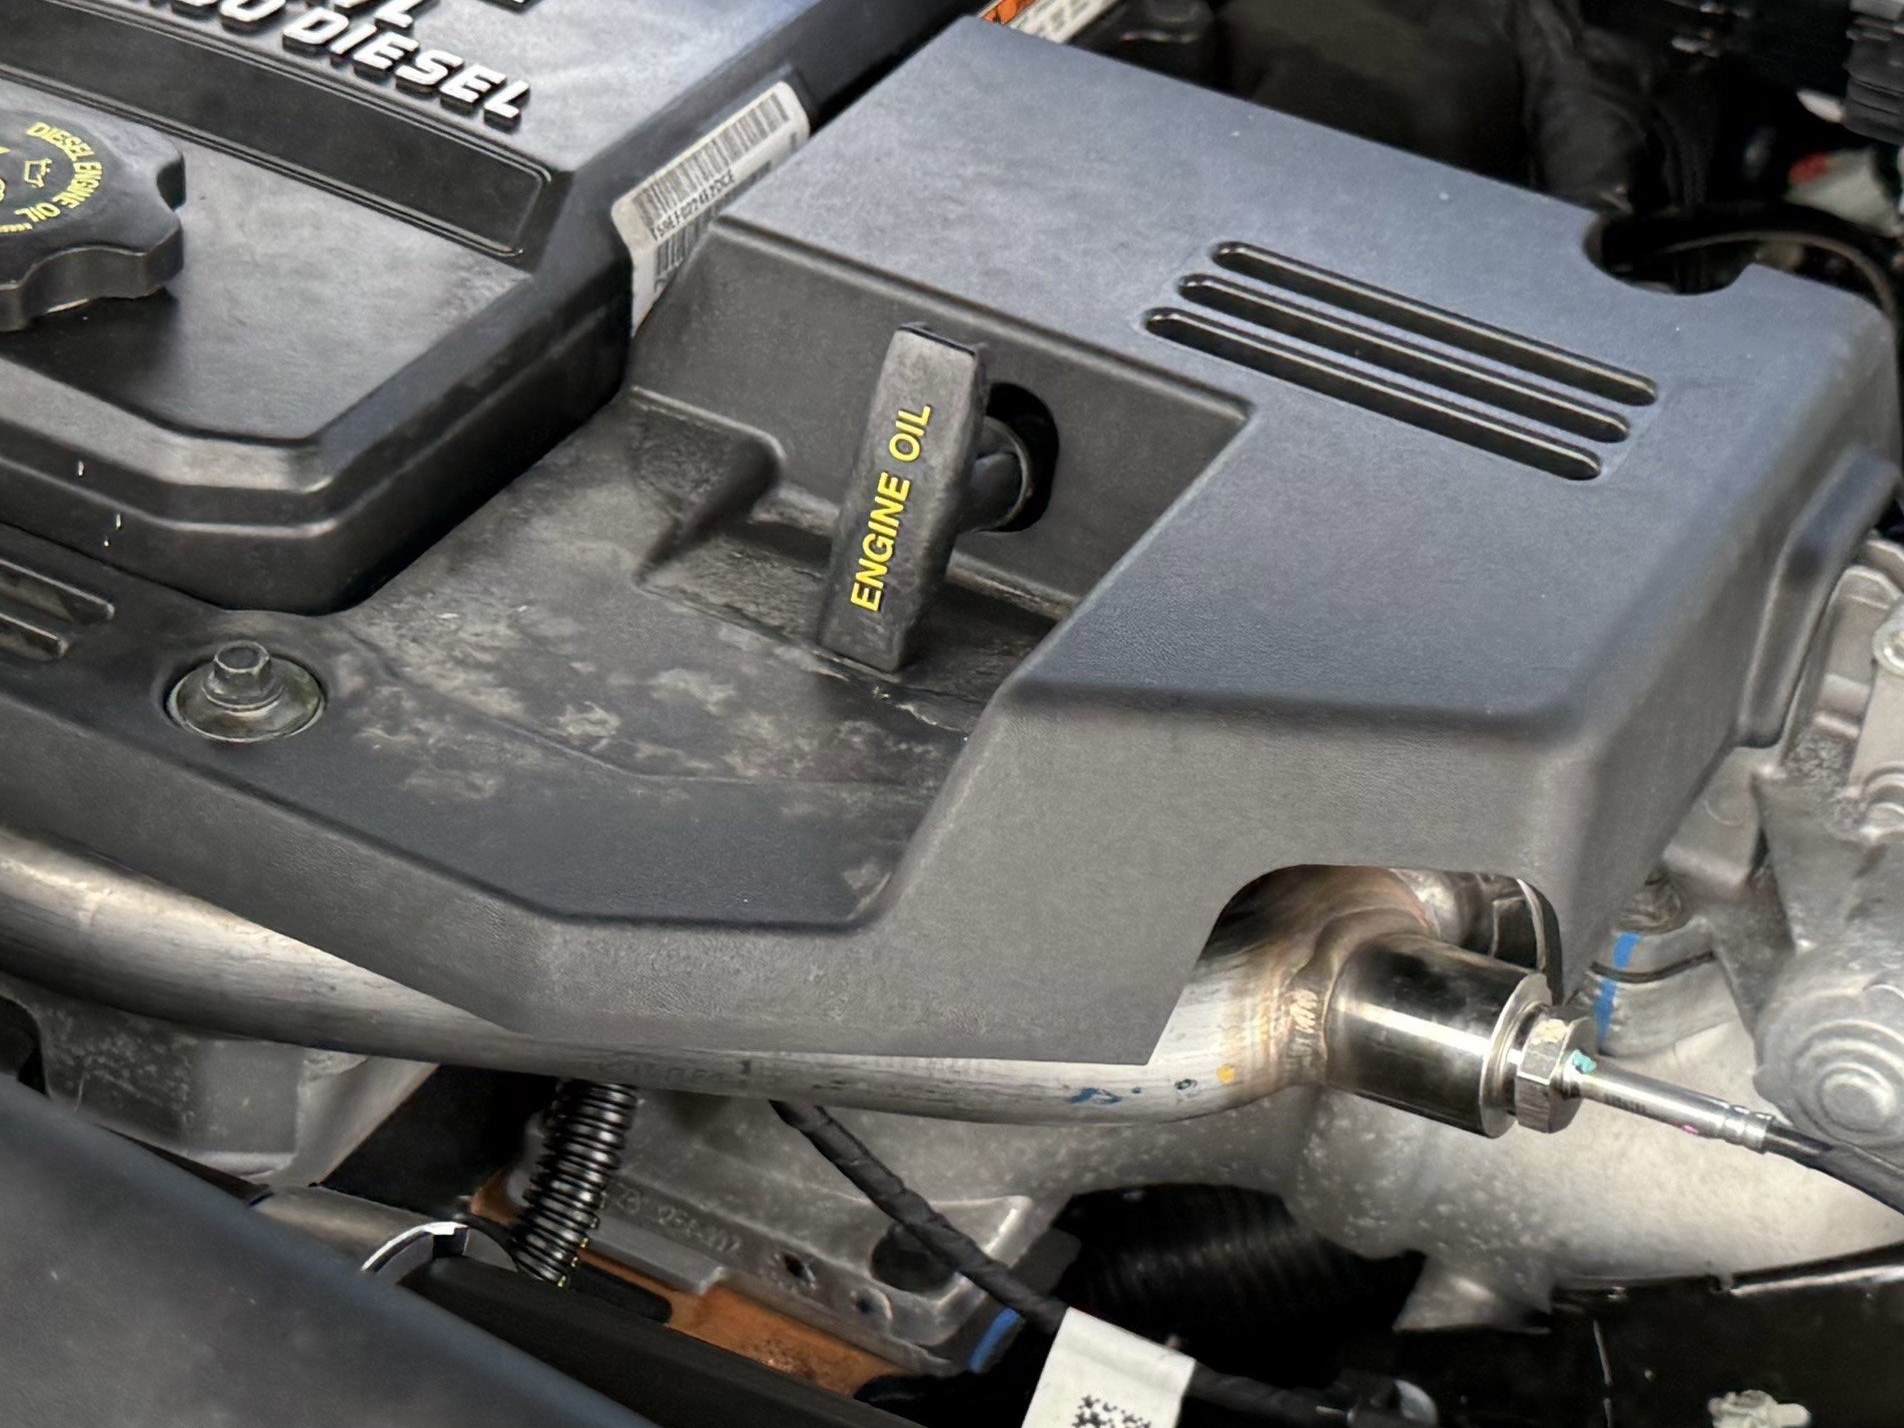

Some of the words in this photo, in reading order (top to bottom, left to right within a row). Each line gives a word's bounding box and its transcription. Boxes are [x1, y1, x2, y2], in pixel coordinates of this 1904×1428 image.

[282, 6, 530, 125] DIESEL
[26, 121, 96, 162] DIESEL
[51, 160, 102, 210] ENGINE
[14, 200, 62, 223] OIL
[849, 470, 913, 614] ENGINE
[887, 403, 932, 463] OIL
